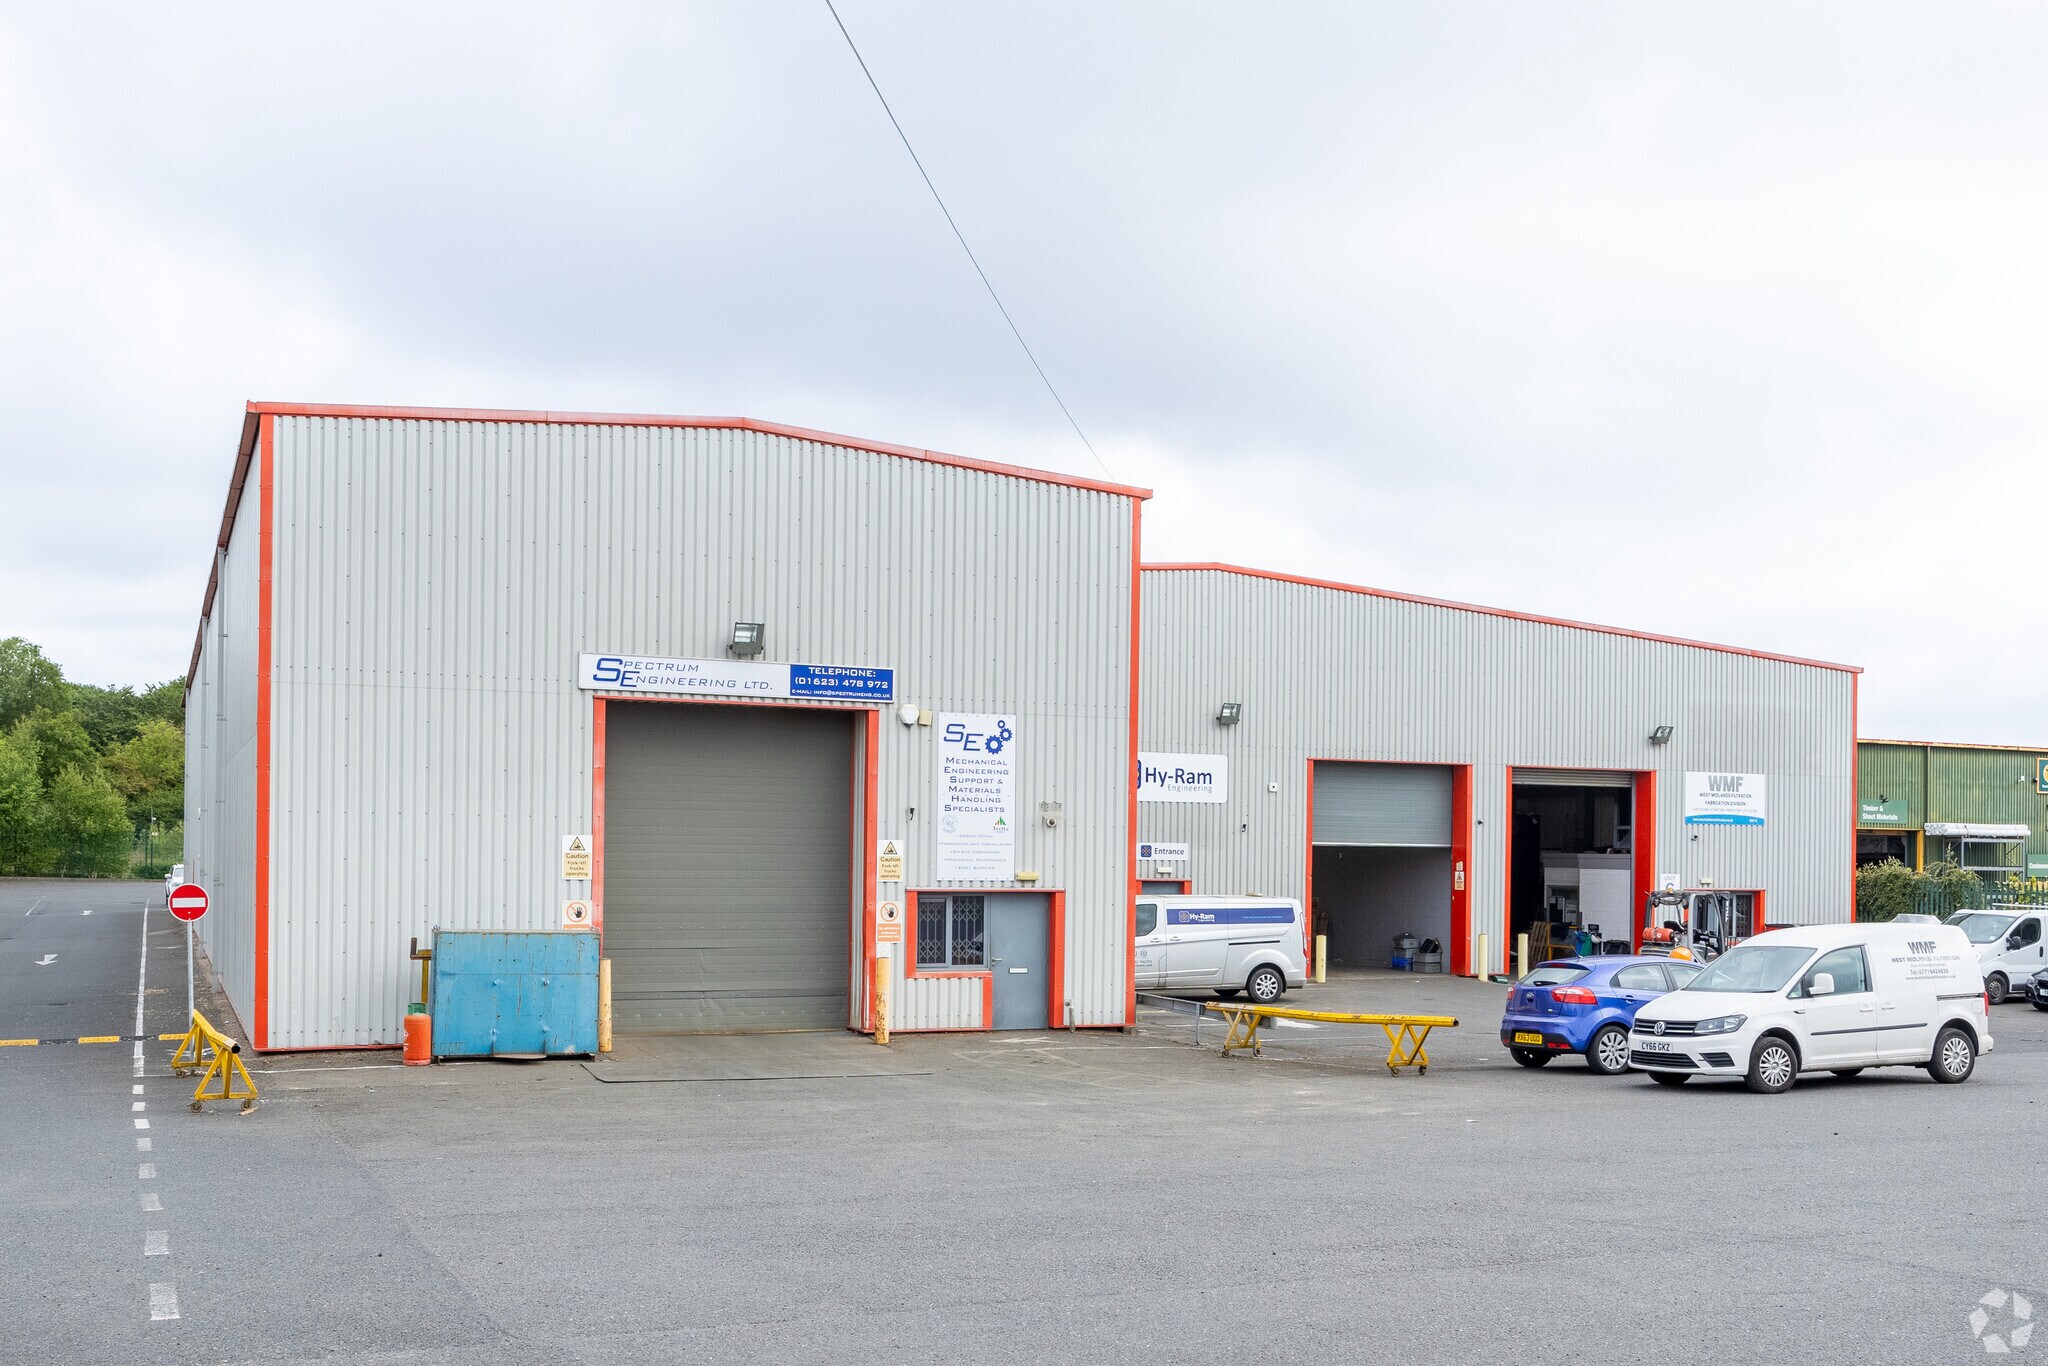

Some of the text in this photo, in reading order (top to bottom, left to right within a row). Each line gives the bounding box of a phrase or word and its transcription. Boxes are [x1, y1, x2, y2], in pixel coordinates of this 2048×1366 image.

[593, 658, 700, 682] SPECTRUM
[808, 666, 876, 678] TELEPHONE:
[620, 670, 774, 690] ENGINEERING LTD.
[795, 677, 888, 689] (01623) 478 972
[946, 756, 1008, 766] MECHANICAL
[944, 766, 1009, 775] ENGINEERING
[950, 776, 994, 784] SUPPORT
[1146, 767, 1212, 788] Hy-Ram
[1168, 784, 1213, 793] Engineering
[1708, 775, 1743, 792] WMF
[949, 786, 1001, 794] MATERIALS
[944, 804, 1005, 813] SPECIALISTS
[1907, 941, 1936, 954] WMF
[1642, 1042, 1670, 1051] CY66 GKZ
